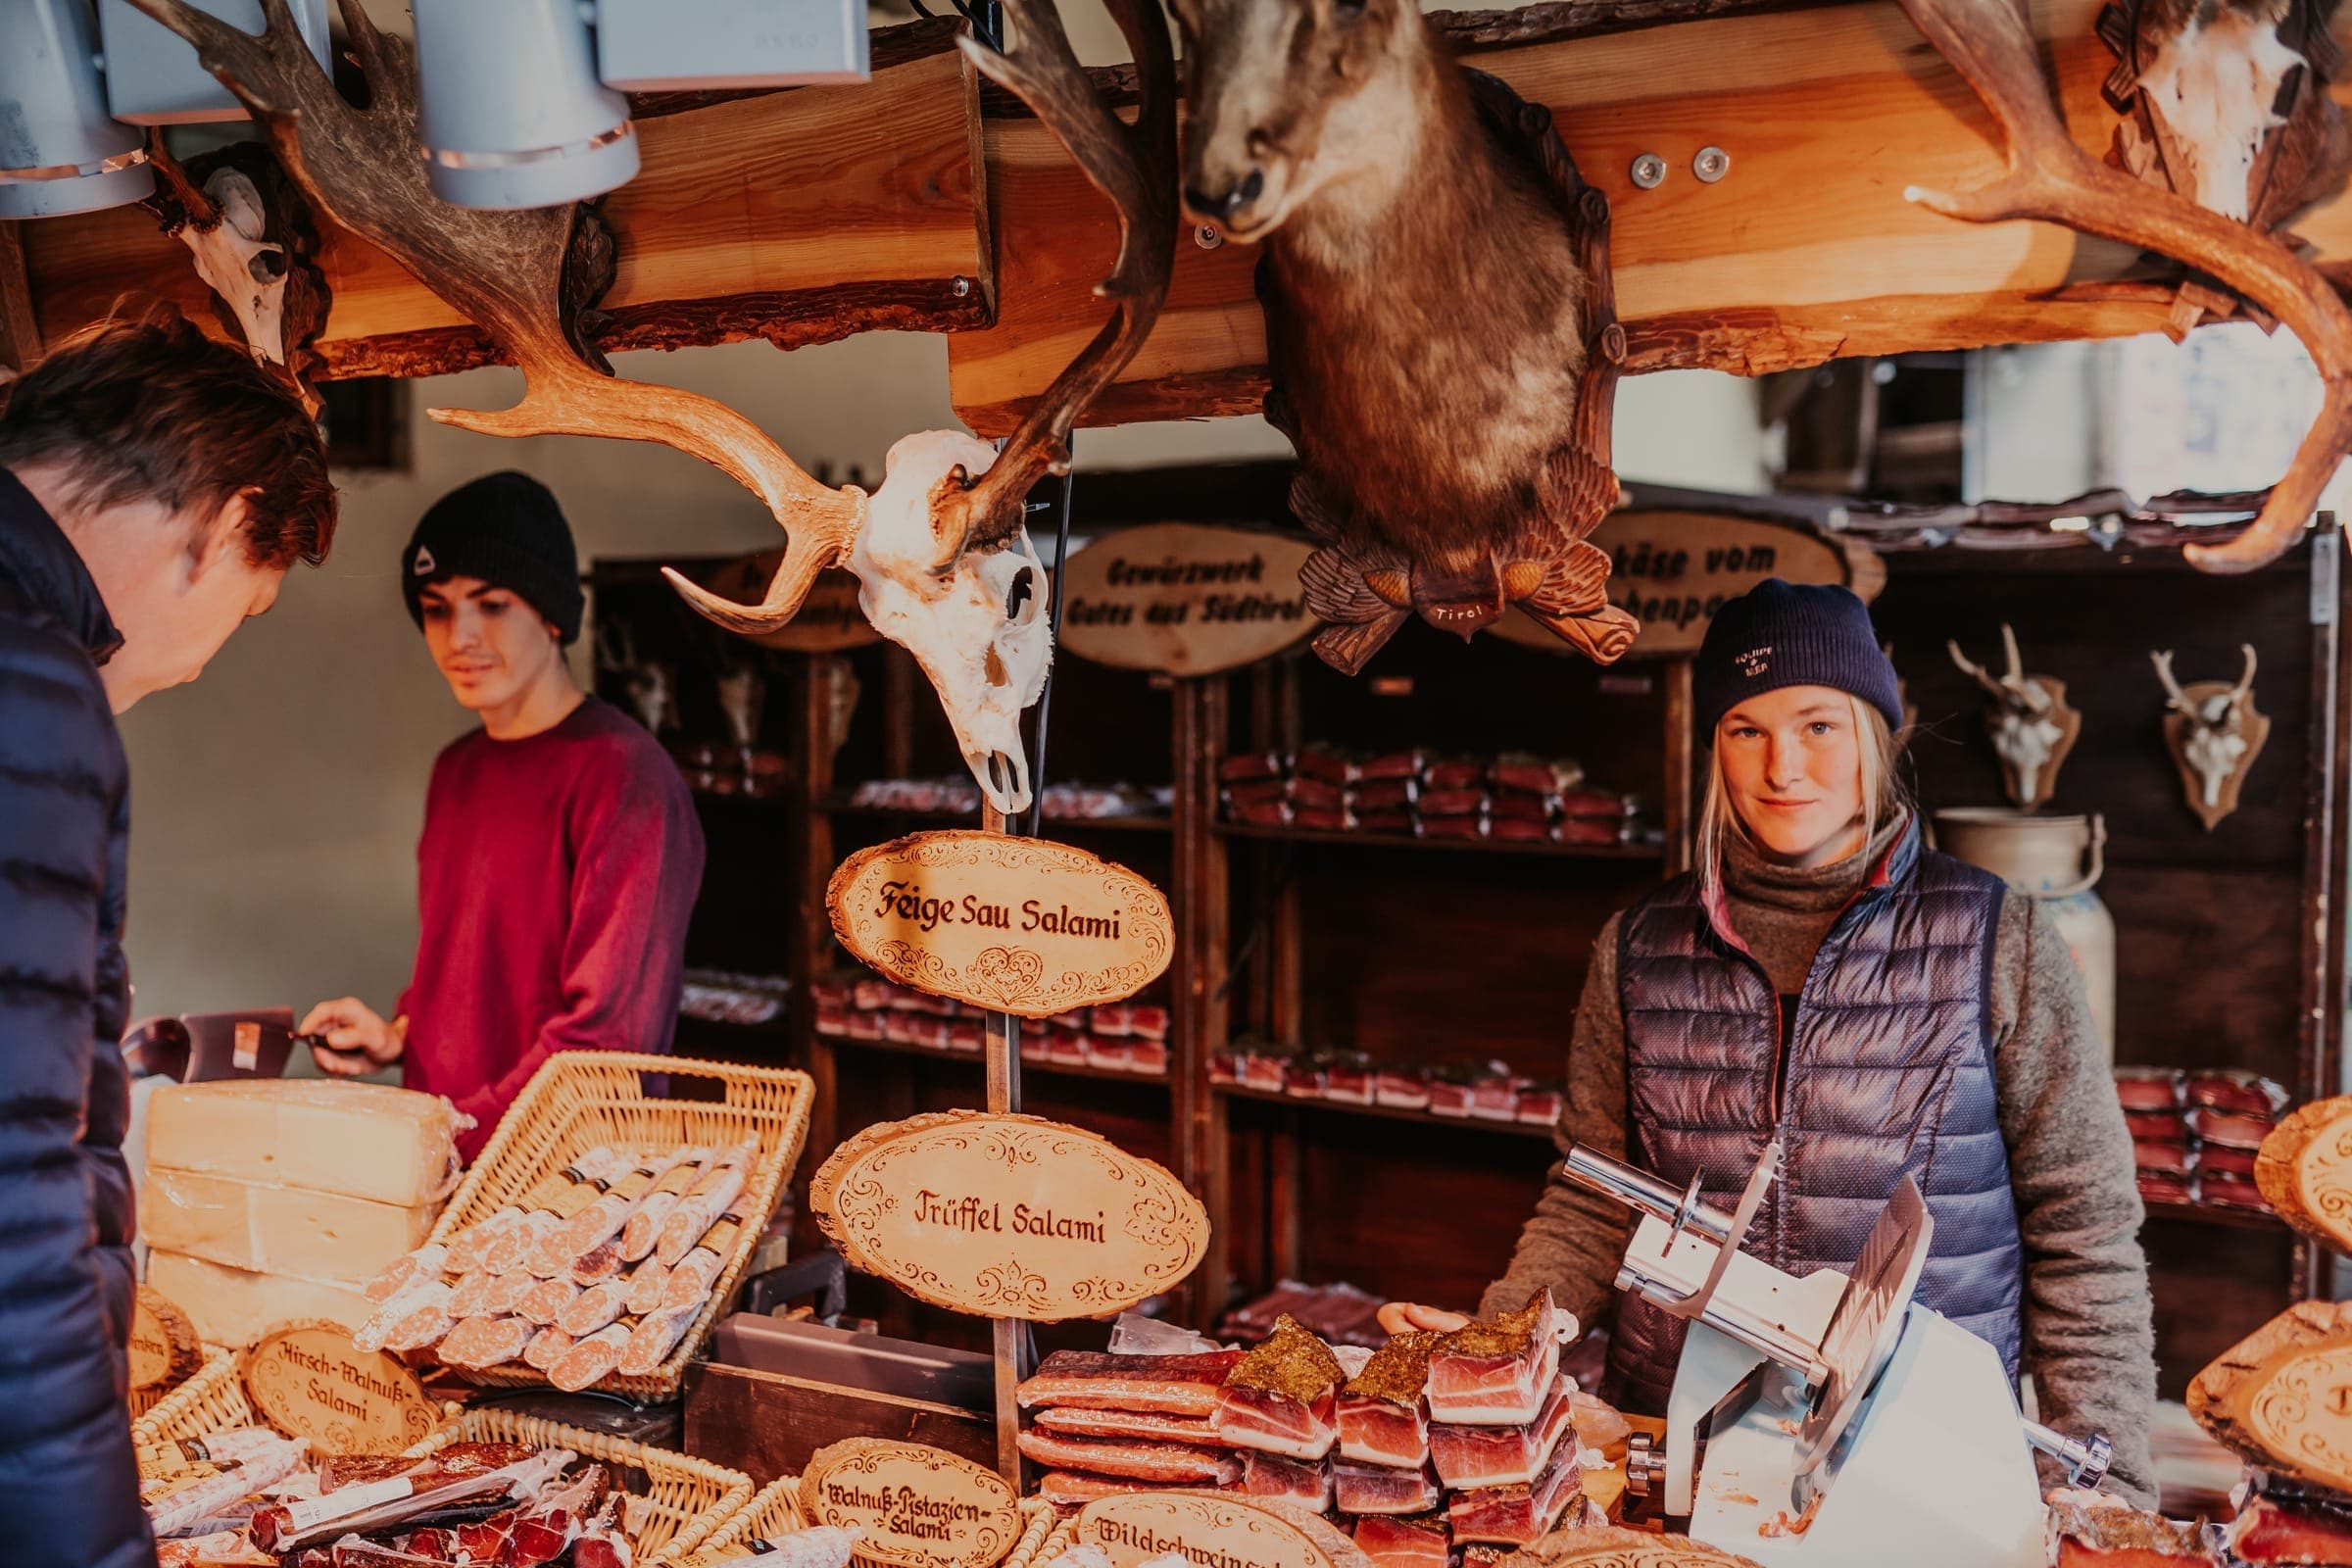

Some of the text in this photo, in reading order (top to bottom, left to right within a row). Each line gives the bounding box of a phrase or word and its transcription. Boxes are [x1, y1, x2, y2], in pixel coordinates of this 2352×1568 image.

[1107, 553, 1264, 586] Gewürzwerk
[1613, 543, 1777, 578] käse vom
[1067, 592, 1305, 626] Gutes aus Südtirol
[1436, 605, 1483, 620] Tirol
[874, 881, 1121, 940] Feige Sau Salami
[914, 1190, 1106, 1244] Trüffel Salami
[307, 1378, 368, 1422] Salami
[889, 1514, 952, 1542] Salami
